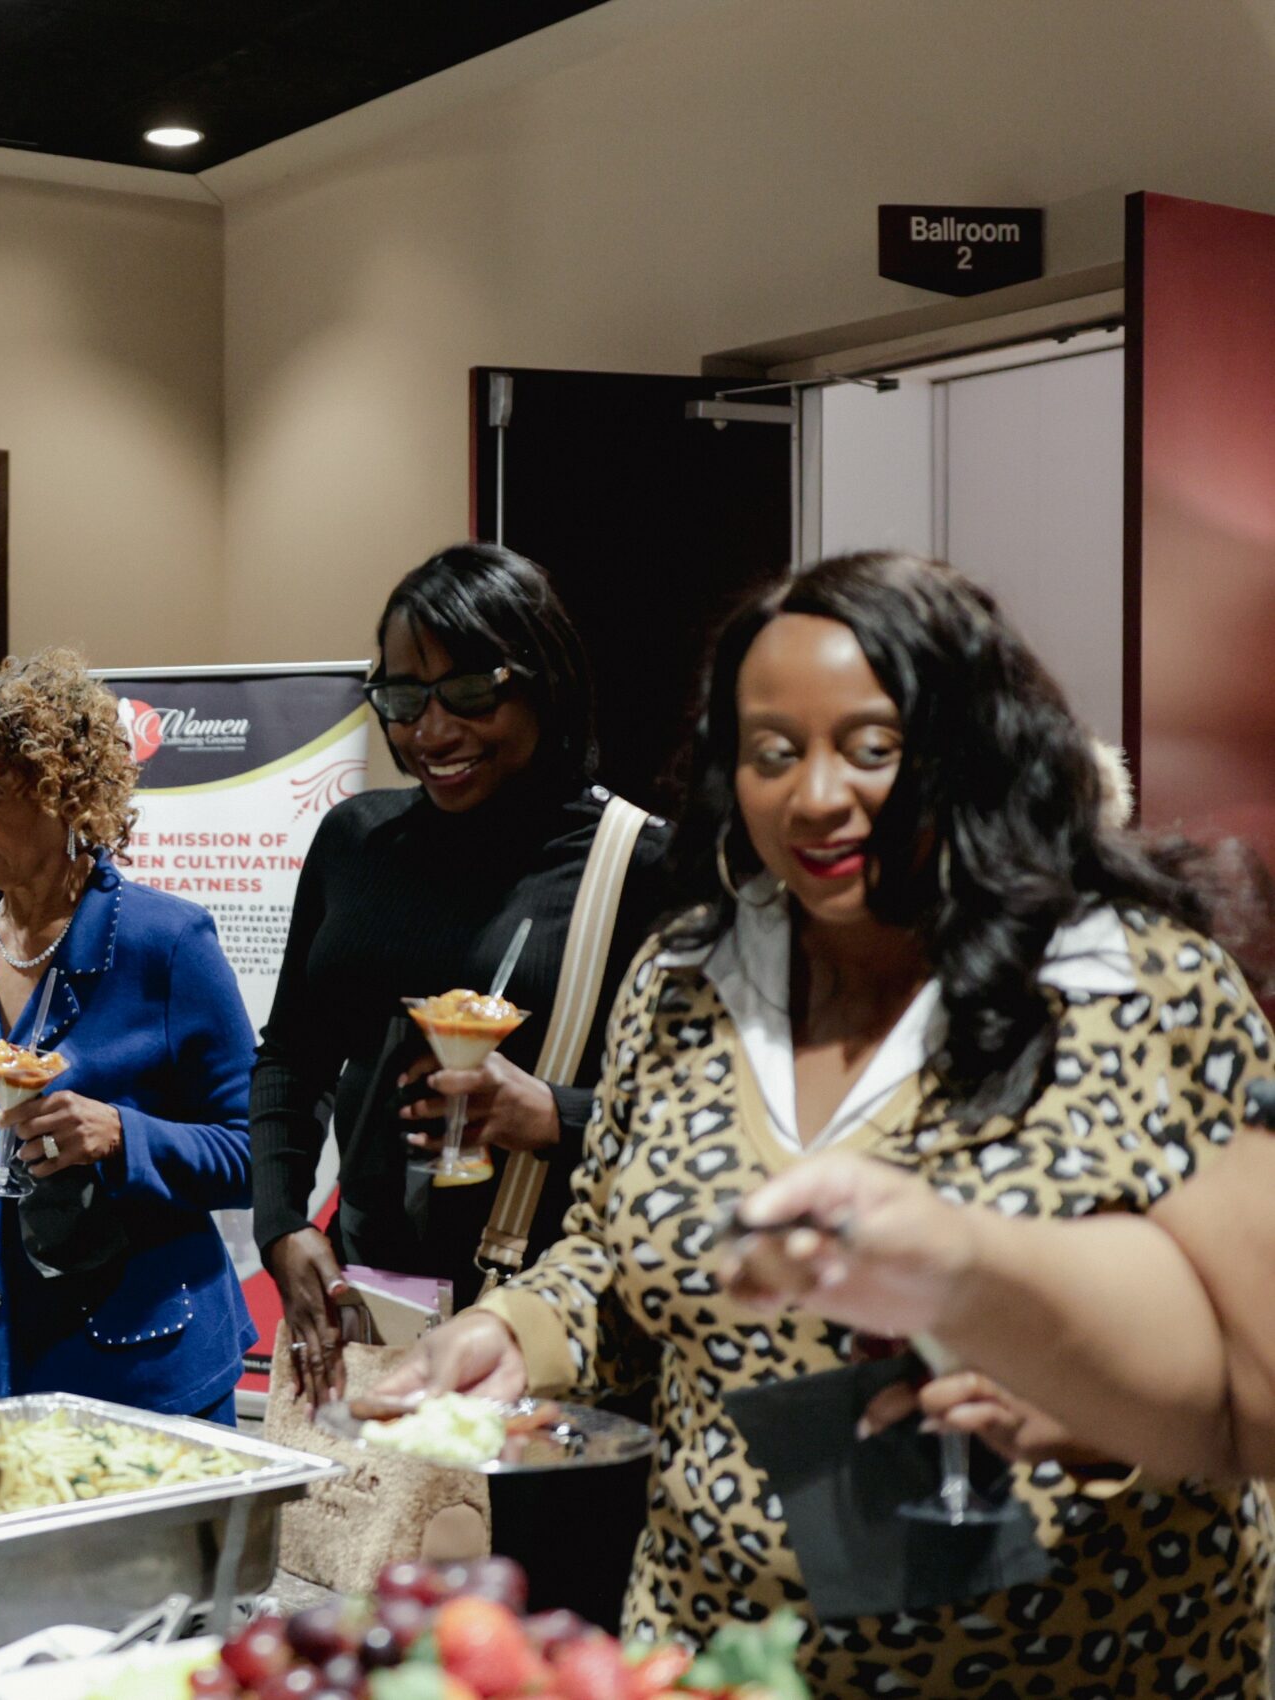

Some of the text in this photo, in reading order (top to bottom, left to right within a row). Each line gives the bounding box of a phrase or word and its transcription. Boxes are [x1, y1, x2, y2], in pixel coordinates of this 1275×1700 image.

[910, 215, 1020, 242] Ballroom
[956, 245, 973, 270] 2
[134, 707, 250, 743] Women
[158, 832, 251, 847] MISSION
[258, 833, 288, 848] OF
[173, 855, 303, 870] CULTIVATIN
[270, 904, 291, 912] BRI
[247, 936, 287, 944] ECONO
[226, 946, 285, 955] DUCATIO
[231, 956, 269, 965] OVING
[260, 968, 278, 976] LIF
